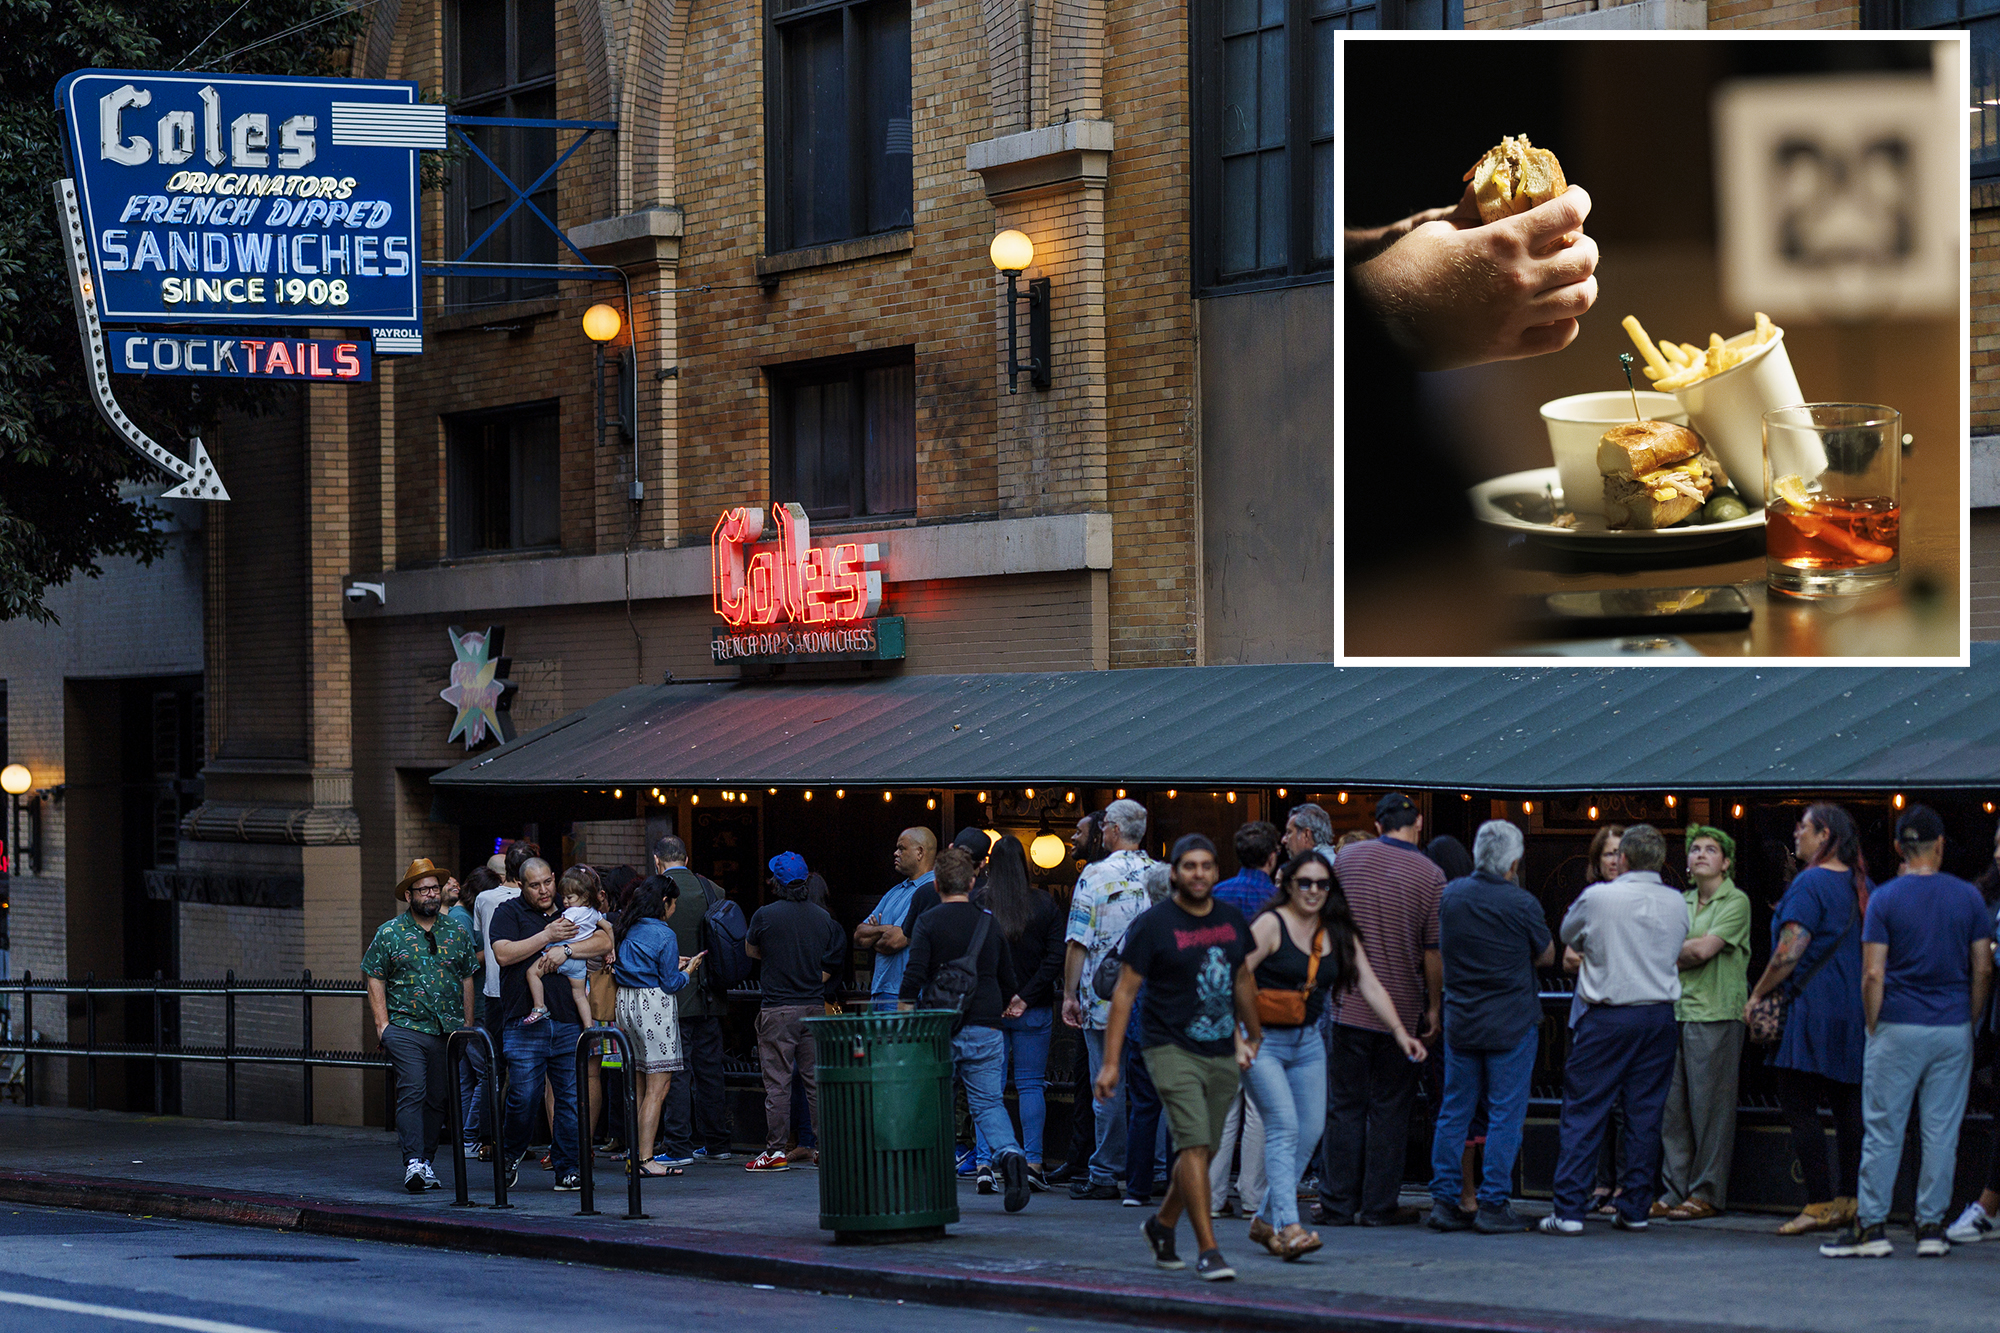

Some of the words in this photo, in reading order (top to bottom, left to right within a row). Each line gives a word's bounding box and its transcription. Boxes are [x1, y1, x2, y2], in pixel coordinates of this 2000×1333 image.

[100, 84, 318, 169] Coles
[166, 171, 357, 200] ORIGINATORS
[119, 195, 261, 226] FRENCH
[265, 199, 393, 228] DIPPED
[102, 229, 410, 276] SANDWICHES
[162, 277, 267, 304] SINCE
[276, 278, 350, 306] 1908
[372, 328, 422, 339] PAYROLL
[125, 336, 360, 377] COCKTAILS
[711, 502, 882, 626] Coles
[710, 634, 758, 660] FRENCH
[760, 632, 782, 655] DIP
[785, 629, 876, 654] SANDWICHES
